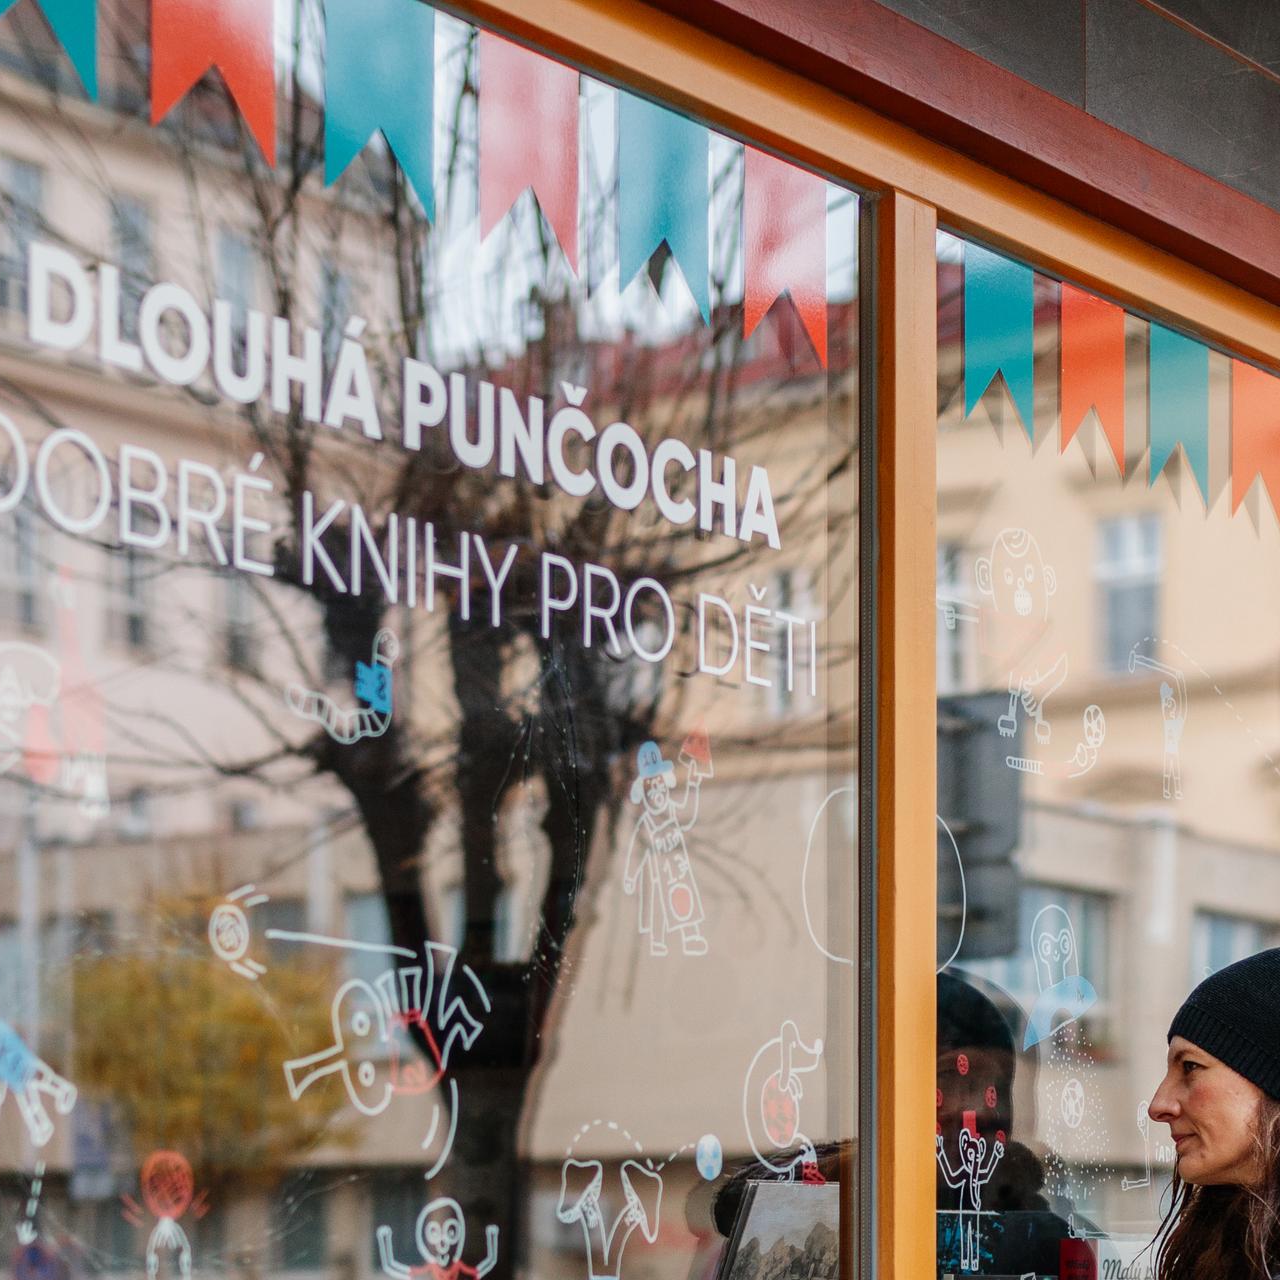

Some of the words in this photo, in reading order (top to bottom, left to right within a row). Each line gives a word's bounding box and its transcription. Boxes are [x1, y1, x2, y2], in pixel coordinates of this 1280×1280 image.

[27, 242, 382, 440] DLOUHÁ
[403, 357, 782, 550] PUNČOCHA
[302, 490, 519, 628] KNIHY
[541, 552, 676, 662] PRO
[698, 583, 818, 697] DĚTI
